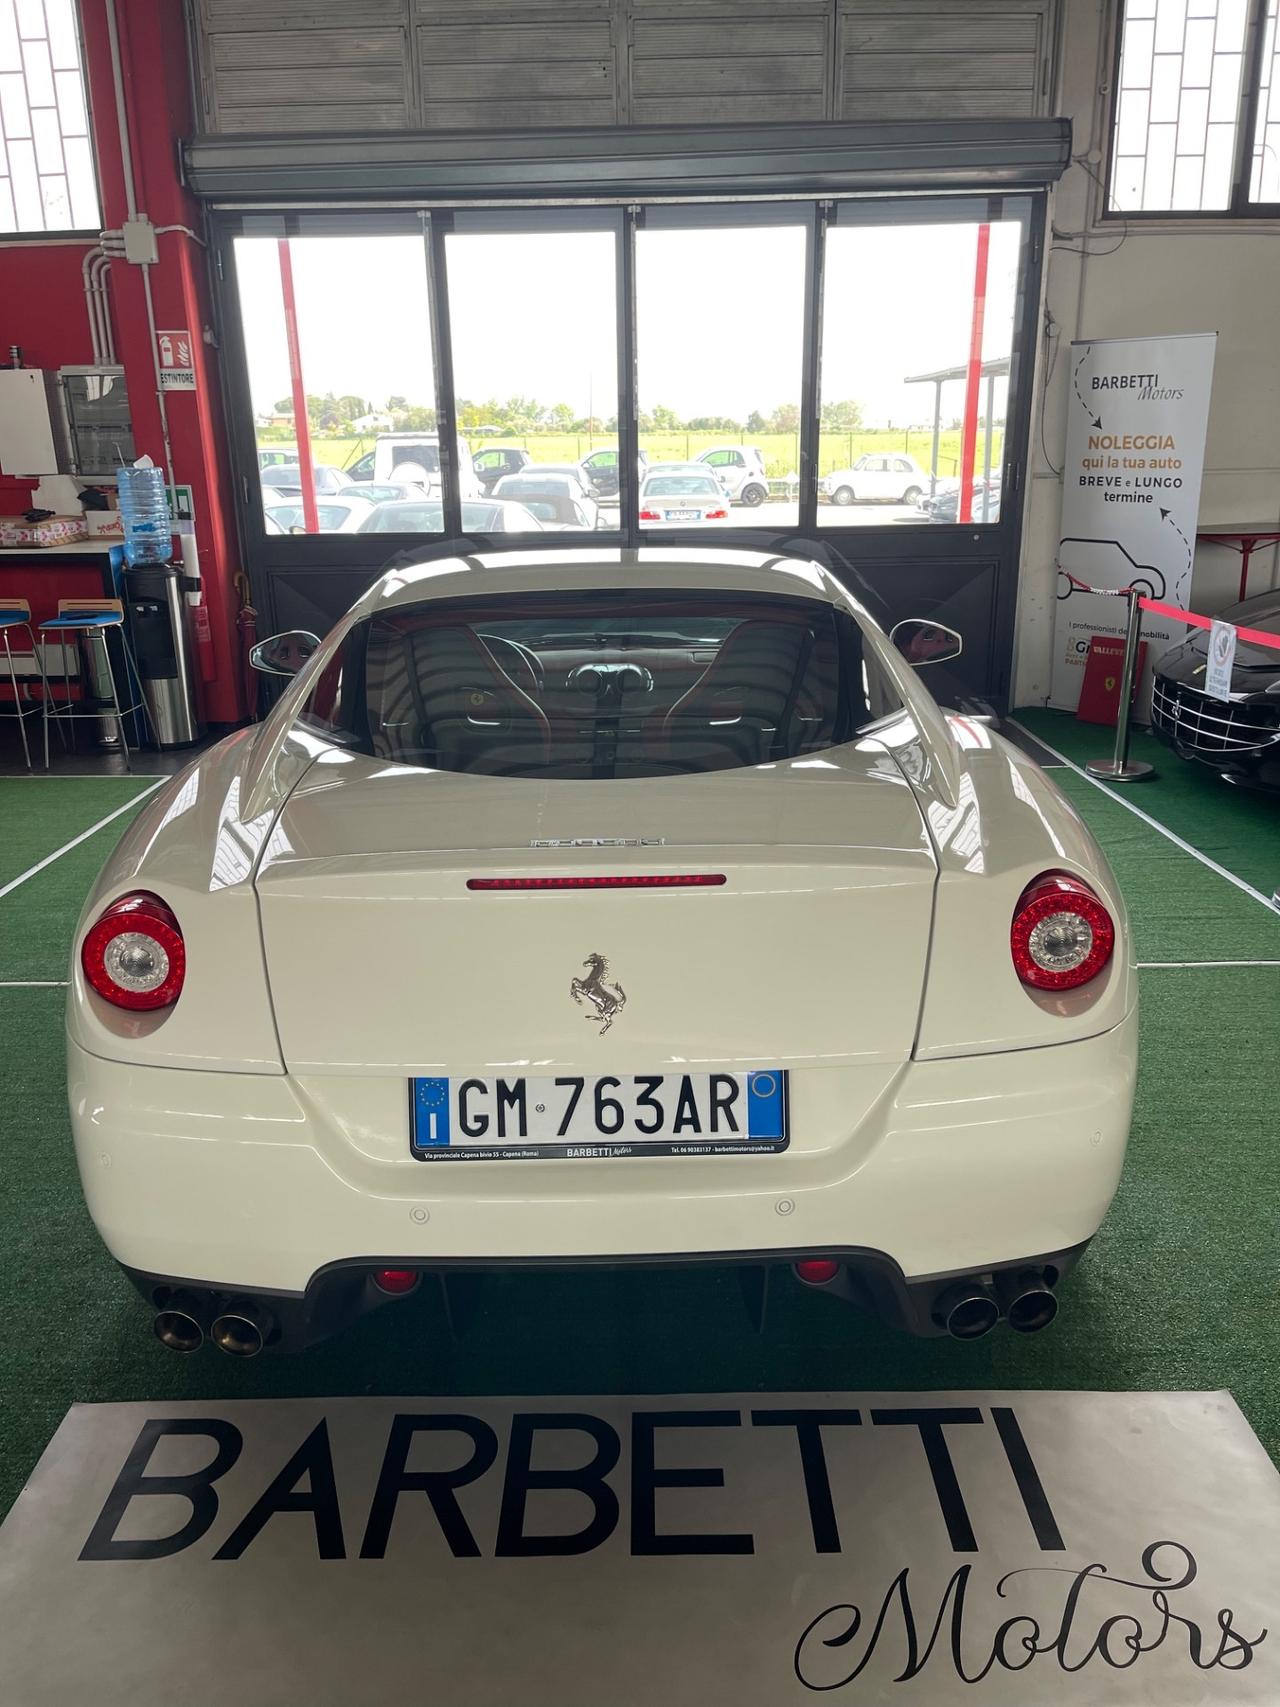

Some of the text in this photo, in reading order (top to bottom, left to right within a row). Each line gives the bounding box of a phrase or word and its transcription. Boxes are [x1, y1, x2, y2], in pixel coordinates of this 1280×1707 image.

[161, 373, 194, 384] ESTINTORE
[1092, 374, 1158, 389] BARBETTI
[1137, 385, 1184, 400] Motors
[1088, 434, 1175, 450] NOLEGGIA
[1082, 455, 1182, 471] qui la tua auto
[1079, 475, 1122, 487] BREVE
[1135, 477, 1183, 488] LUNGO
[1104, 491, 1153, 503] termine
[1072, 621, 1117, 633] professionisti
[430, 1074, 740, 1139] I GM 763AR
[433, 1152, 460, 1160] provinciale
[460, 1152, 479, 1160] Capena
[566, 1147, 612, 1157] BARBETTI
[78, 1407, 1067, 1561] BARBETTI
[795, 1541, 1268, 1691] Motors
